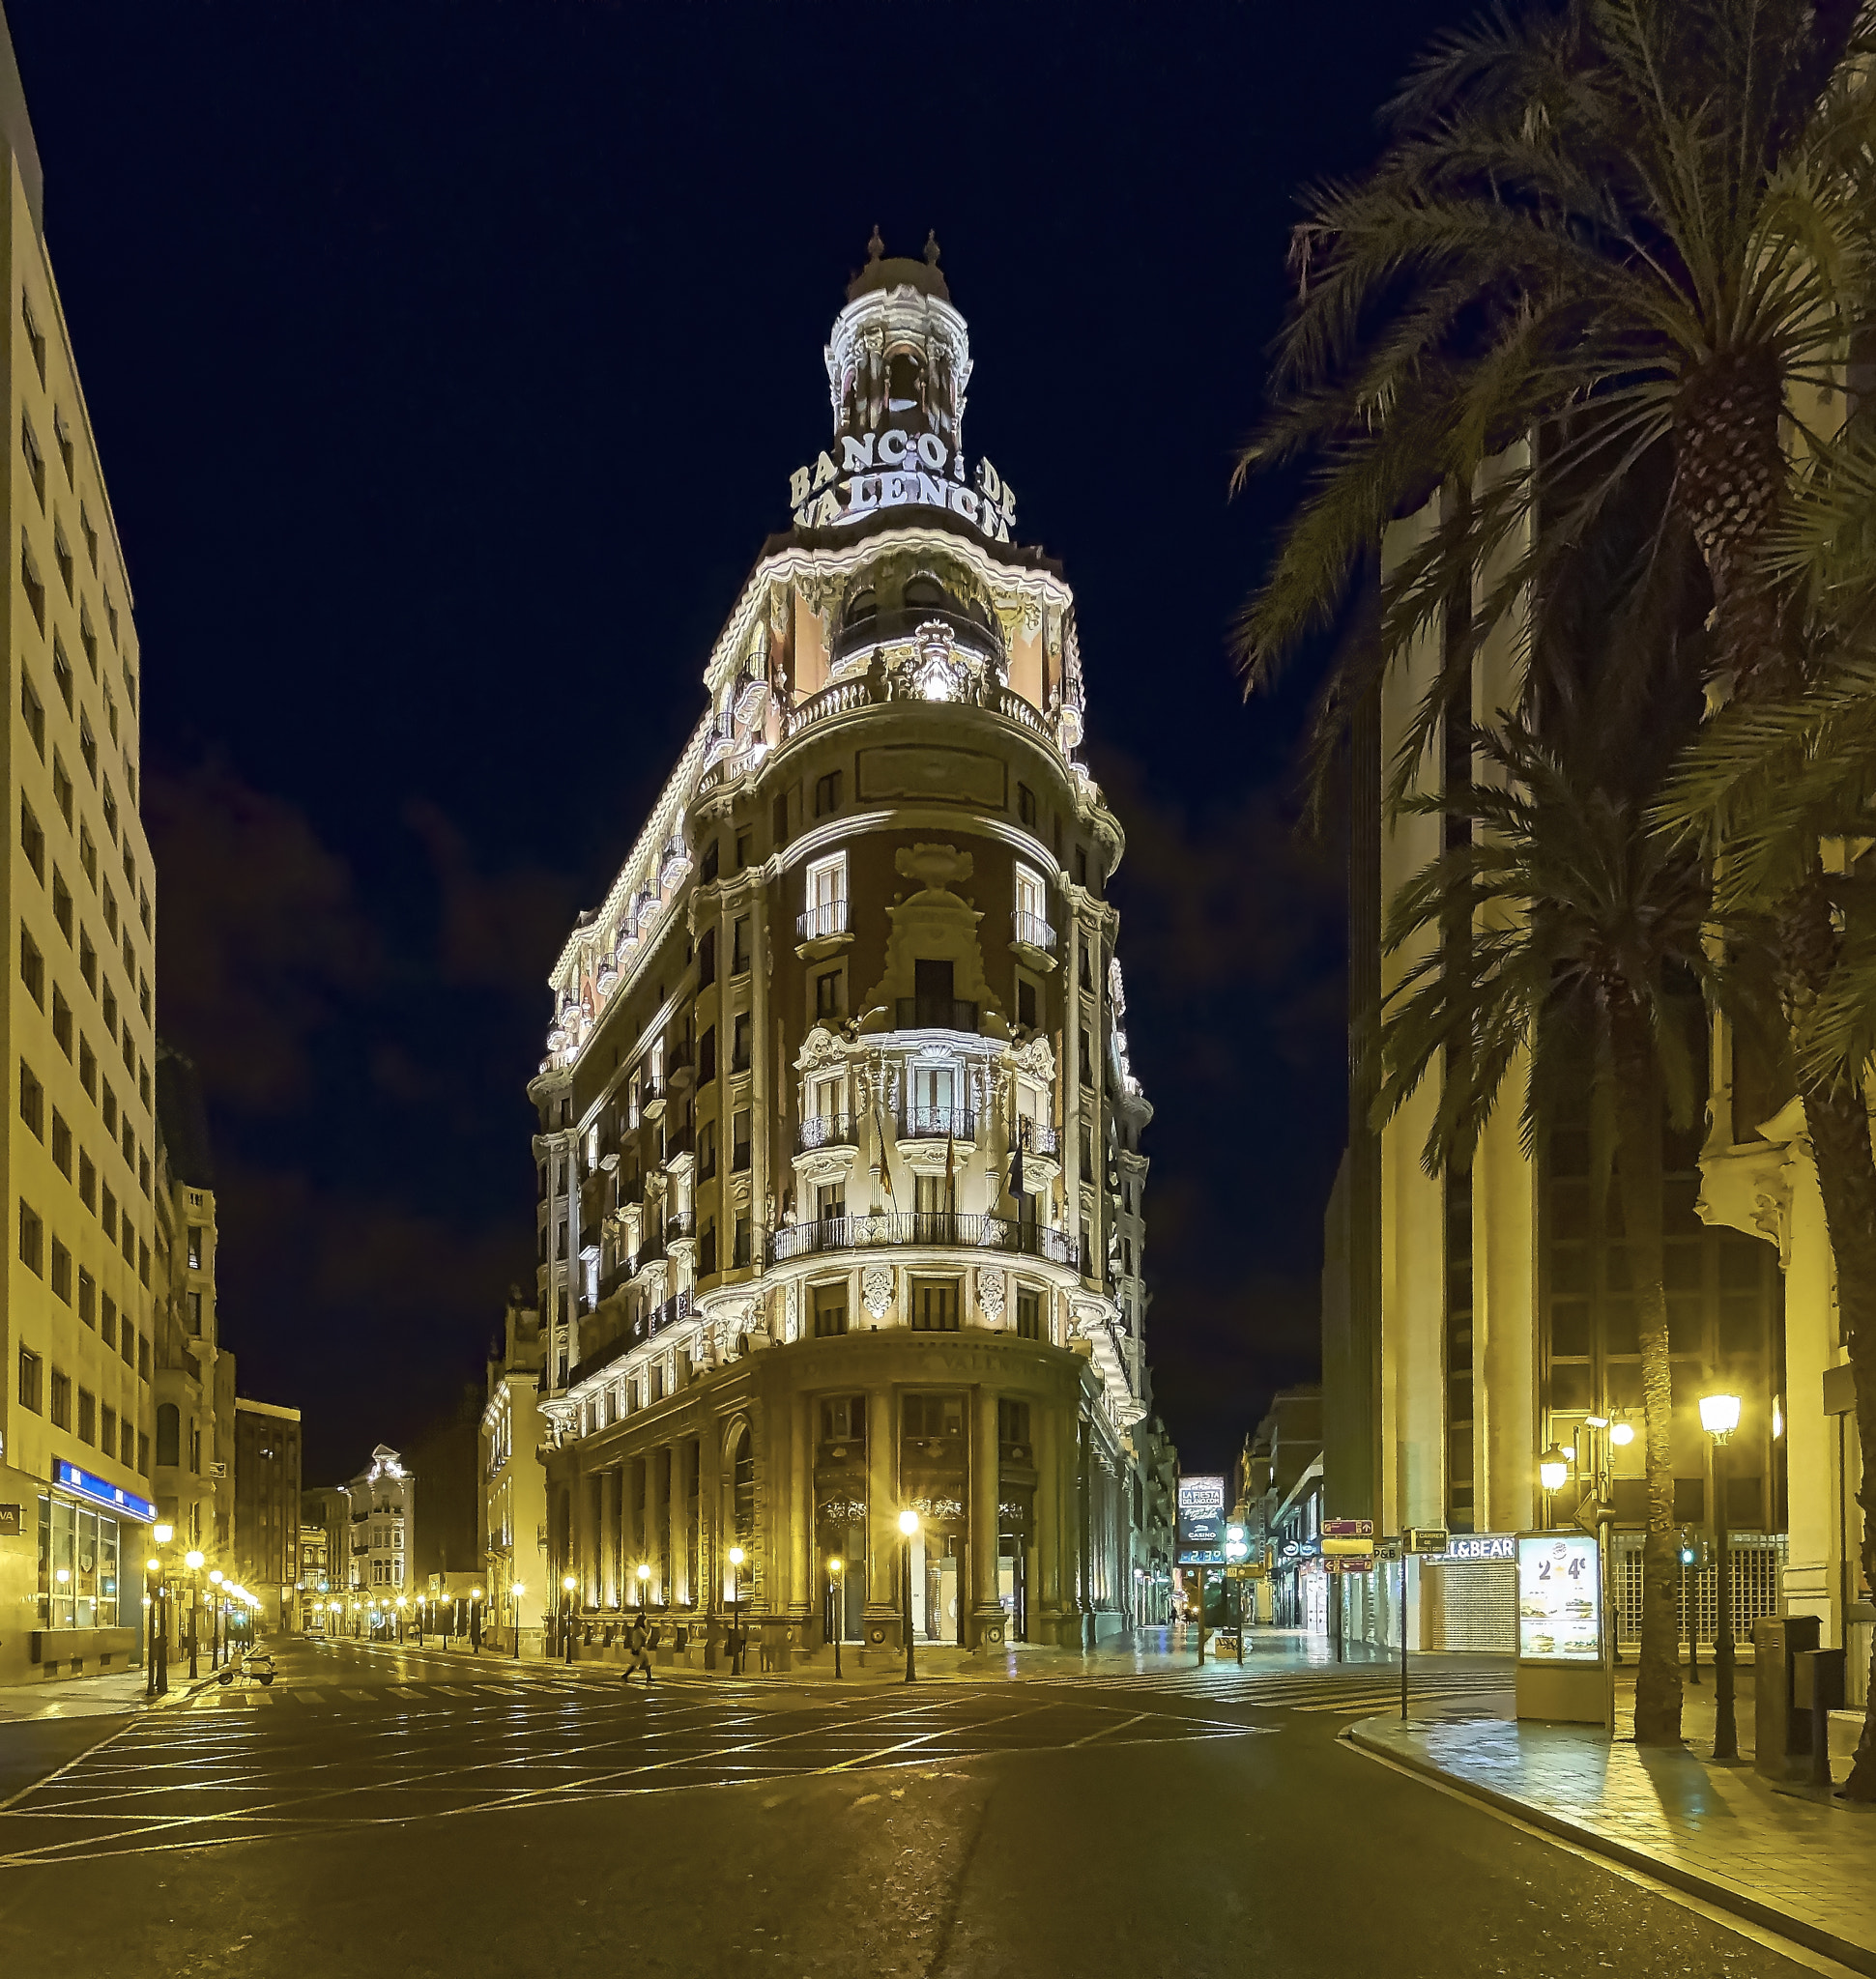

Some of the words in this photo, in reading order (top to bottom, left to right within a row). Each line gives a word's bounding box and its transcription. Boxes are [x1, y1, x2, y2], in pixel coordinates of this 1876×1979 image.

[790, 429, 948, 509] BANCO
[980, 456, 1017, 527] DE
[794, 471, 1010, 544] VALENCIA
[1182, 1490, 1193, 1499] LA
[1539, 1560, 1551, 1581] 2
